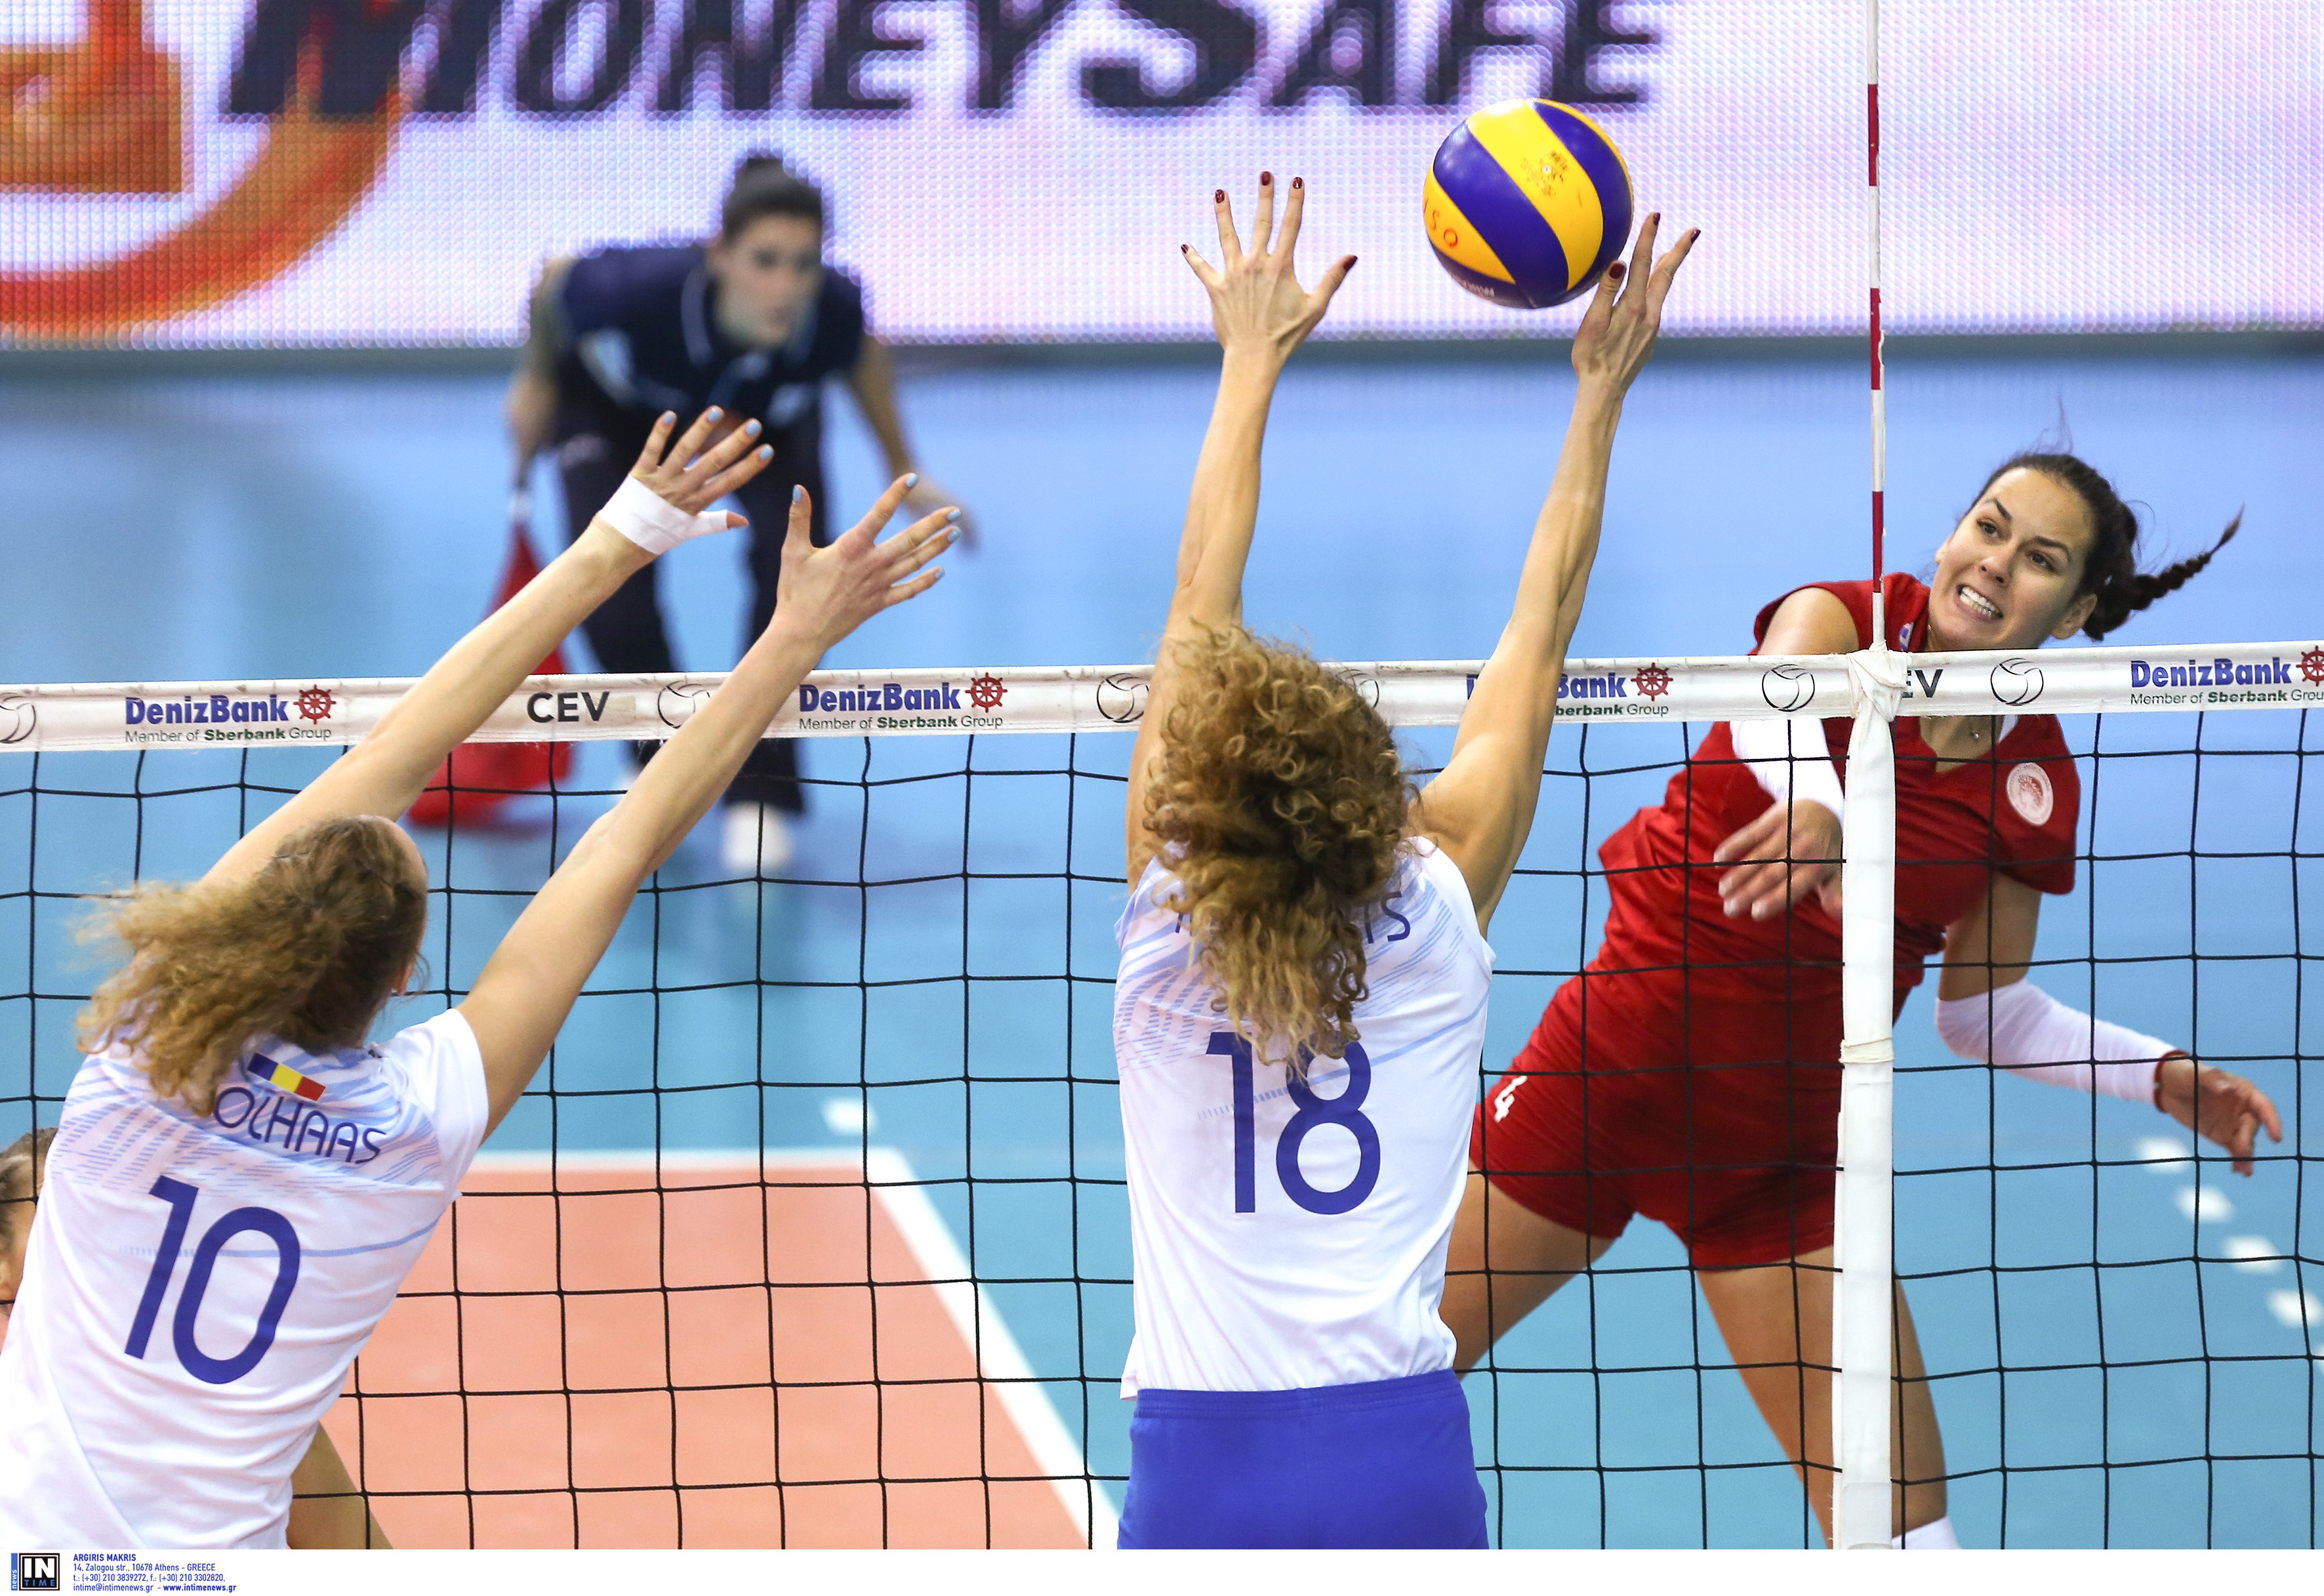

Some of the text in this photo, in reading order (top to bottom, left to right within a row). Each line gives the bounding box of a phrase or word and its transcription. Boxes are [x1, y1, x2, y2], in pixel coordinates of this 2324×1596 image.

[2131, 657, 2292, 687] DenizBank
[125, 693, 289, 724] DenizBank
[527, 691, 609, 723] CEV
[799, 682, 961, 712] DenizBank
[1555, 703, 1669, 716] berbank Group
[2130, 689, 2324, 705] Member of Sberbank Grou
[125, 727, 332, 743] Member of Sberbank Group
[799, 714, 1003, 729] Member of Sberbank Group
[1206, 1031, 1381, 1215] 18
[123, 1174, 301, 1384] 10
